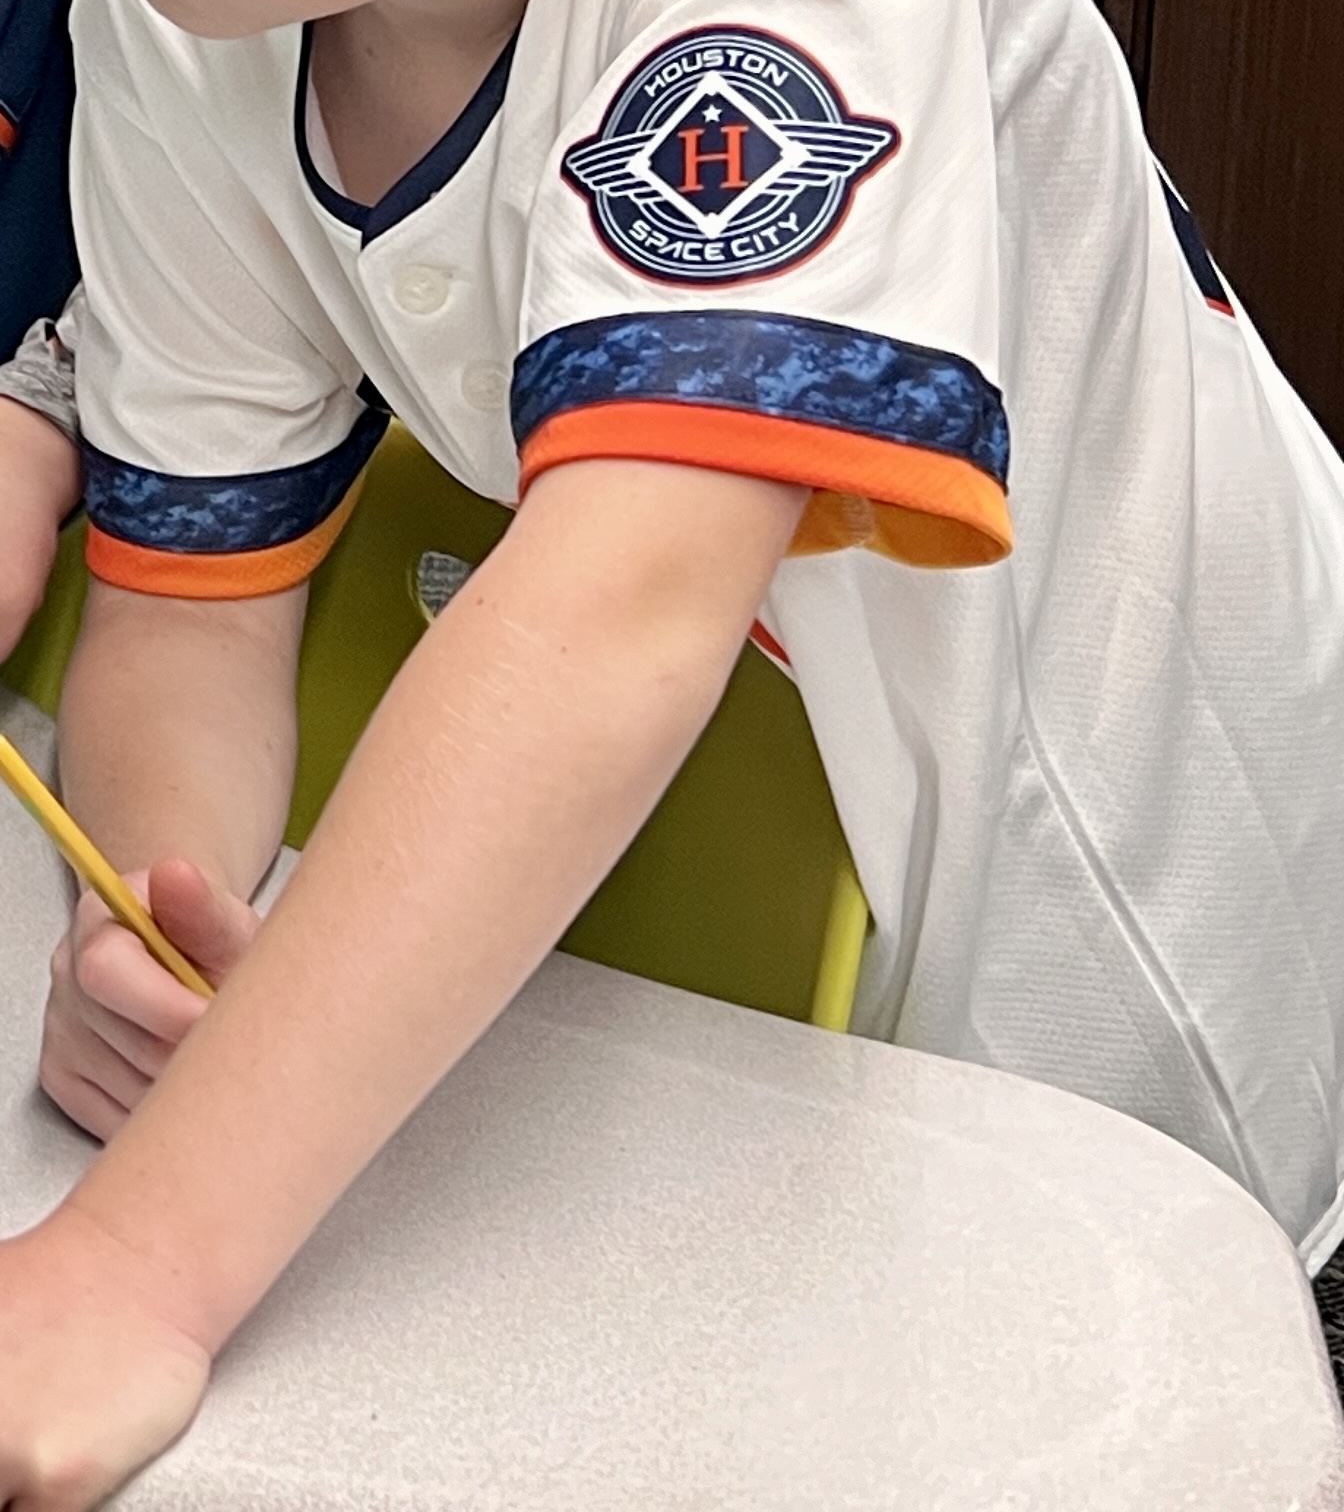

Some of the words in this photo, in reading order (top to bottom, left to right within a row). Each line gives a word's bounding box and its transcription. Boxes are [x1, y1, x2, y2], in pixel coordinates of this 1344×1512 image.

[644, 48, 790, 98] HOUSTON
[677, 124, 749, 193] H
[628, 218, 726, 263] SPACE
[732, 212, 802, 260] CITY
